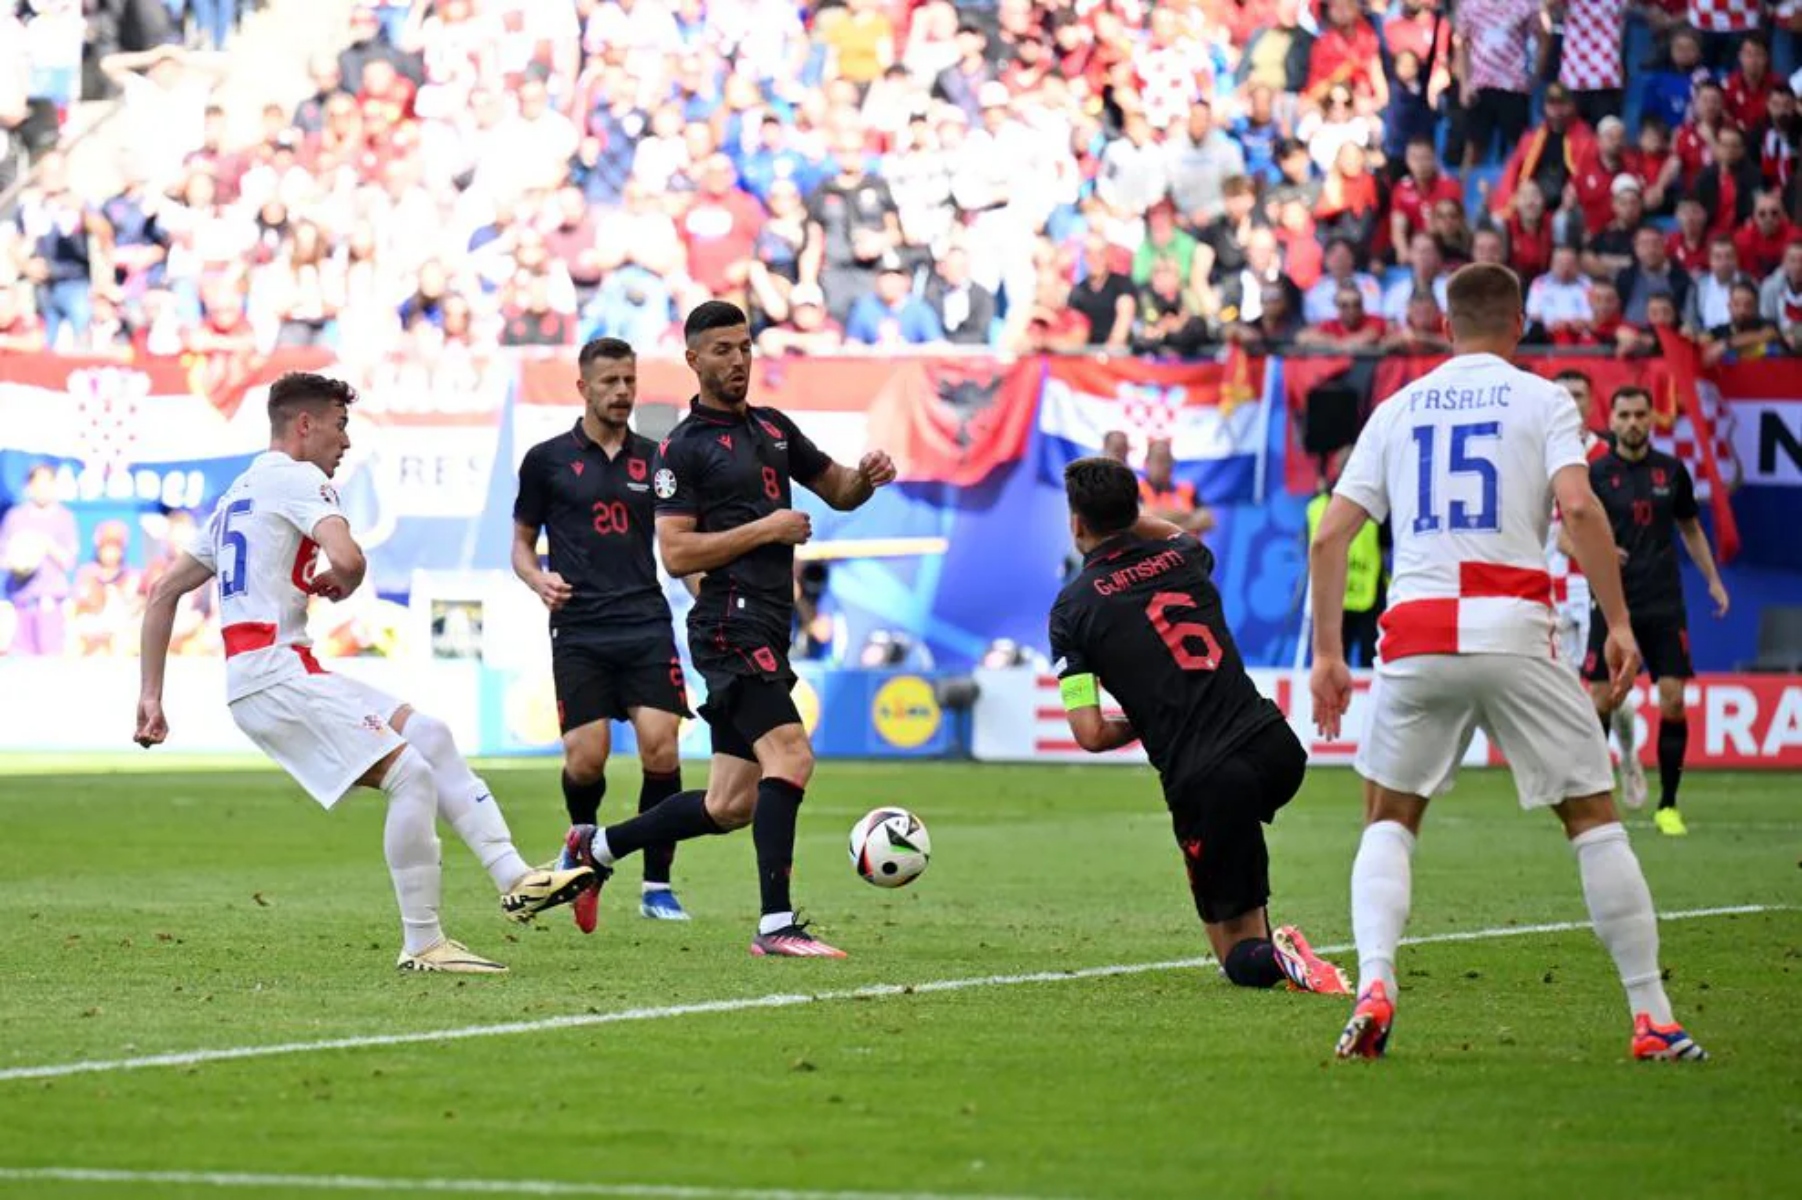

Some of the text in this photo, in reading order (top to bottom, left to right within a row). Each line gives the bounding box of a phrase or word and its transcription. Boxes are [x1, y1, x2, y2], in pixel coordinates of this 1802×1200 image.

[762, 466, 779, 499] 8
[1412, 421, 1502, 533] 15
[592, 501, 628, 535] 20
[1145, 591, 1223, 671] 6
